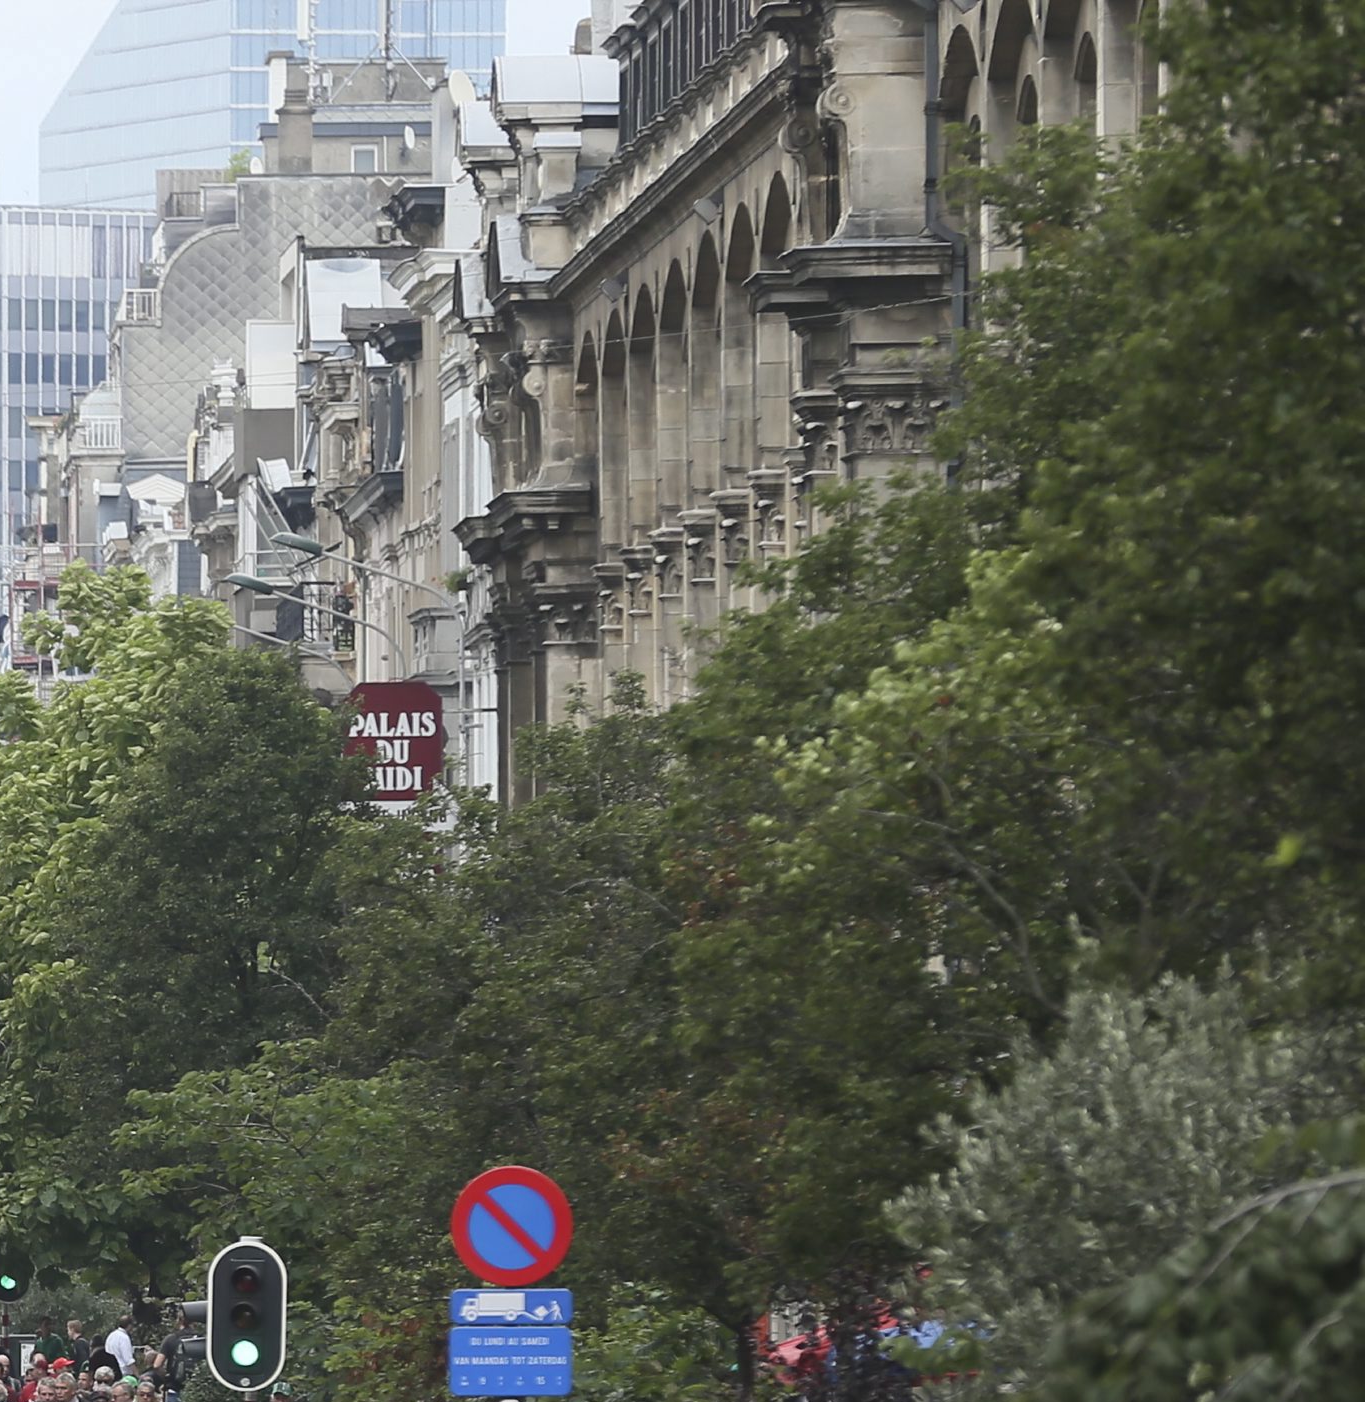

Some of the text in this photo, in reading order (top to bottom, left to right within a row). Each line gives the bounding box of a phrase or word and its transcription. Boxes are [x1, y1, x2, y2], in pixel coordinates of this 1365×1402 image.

[349, 711, 437, 737] PALAIS
[376, 739, 410, 764] DU
[512, 1356, 526, 1365] TOT
[528, 1356, 567, 1365] ZATERDAG
